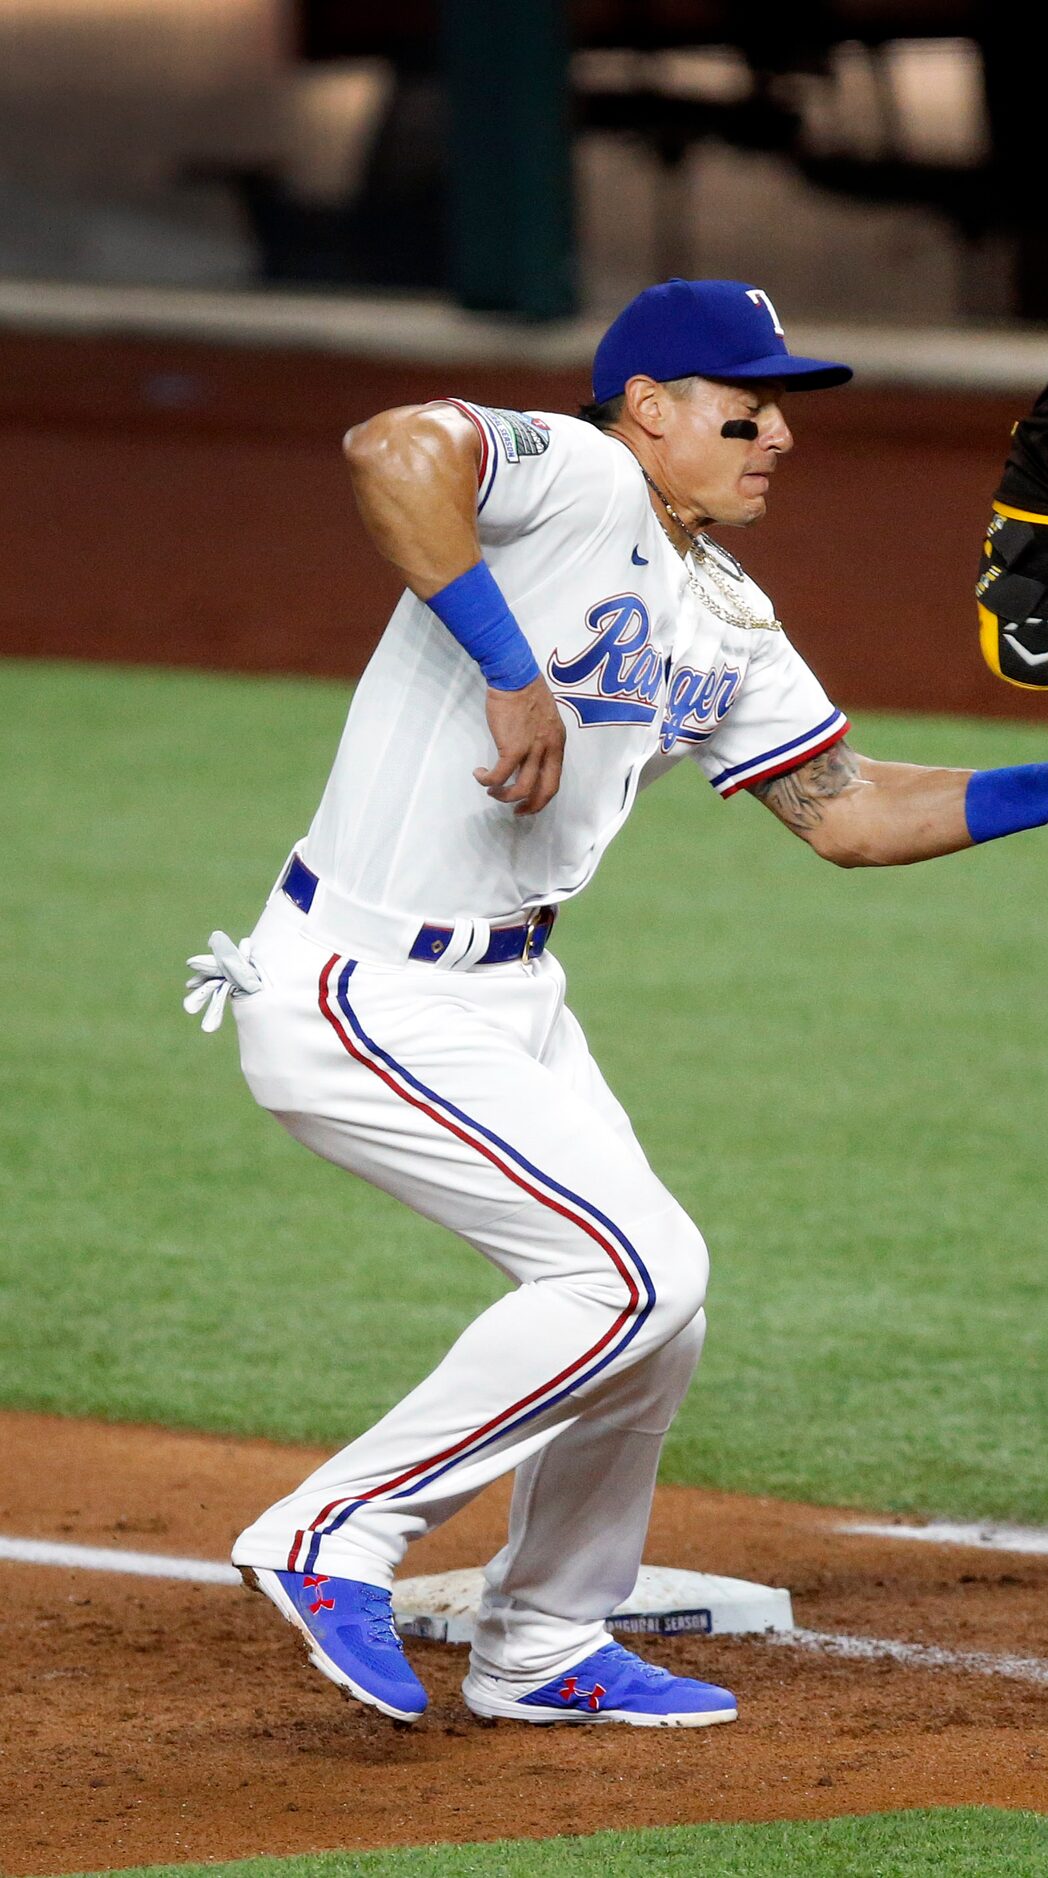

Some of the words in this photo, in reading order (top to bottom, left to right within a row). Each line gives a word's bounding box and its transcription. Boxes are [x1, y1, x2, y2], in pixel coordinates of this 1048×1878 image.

[745, 289, 785, 339] T
[499, 427, 516, 458] SEASON
[547, 591, 742, 754] Rager
[663, 1612, 708, 1632] SEASON
